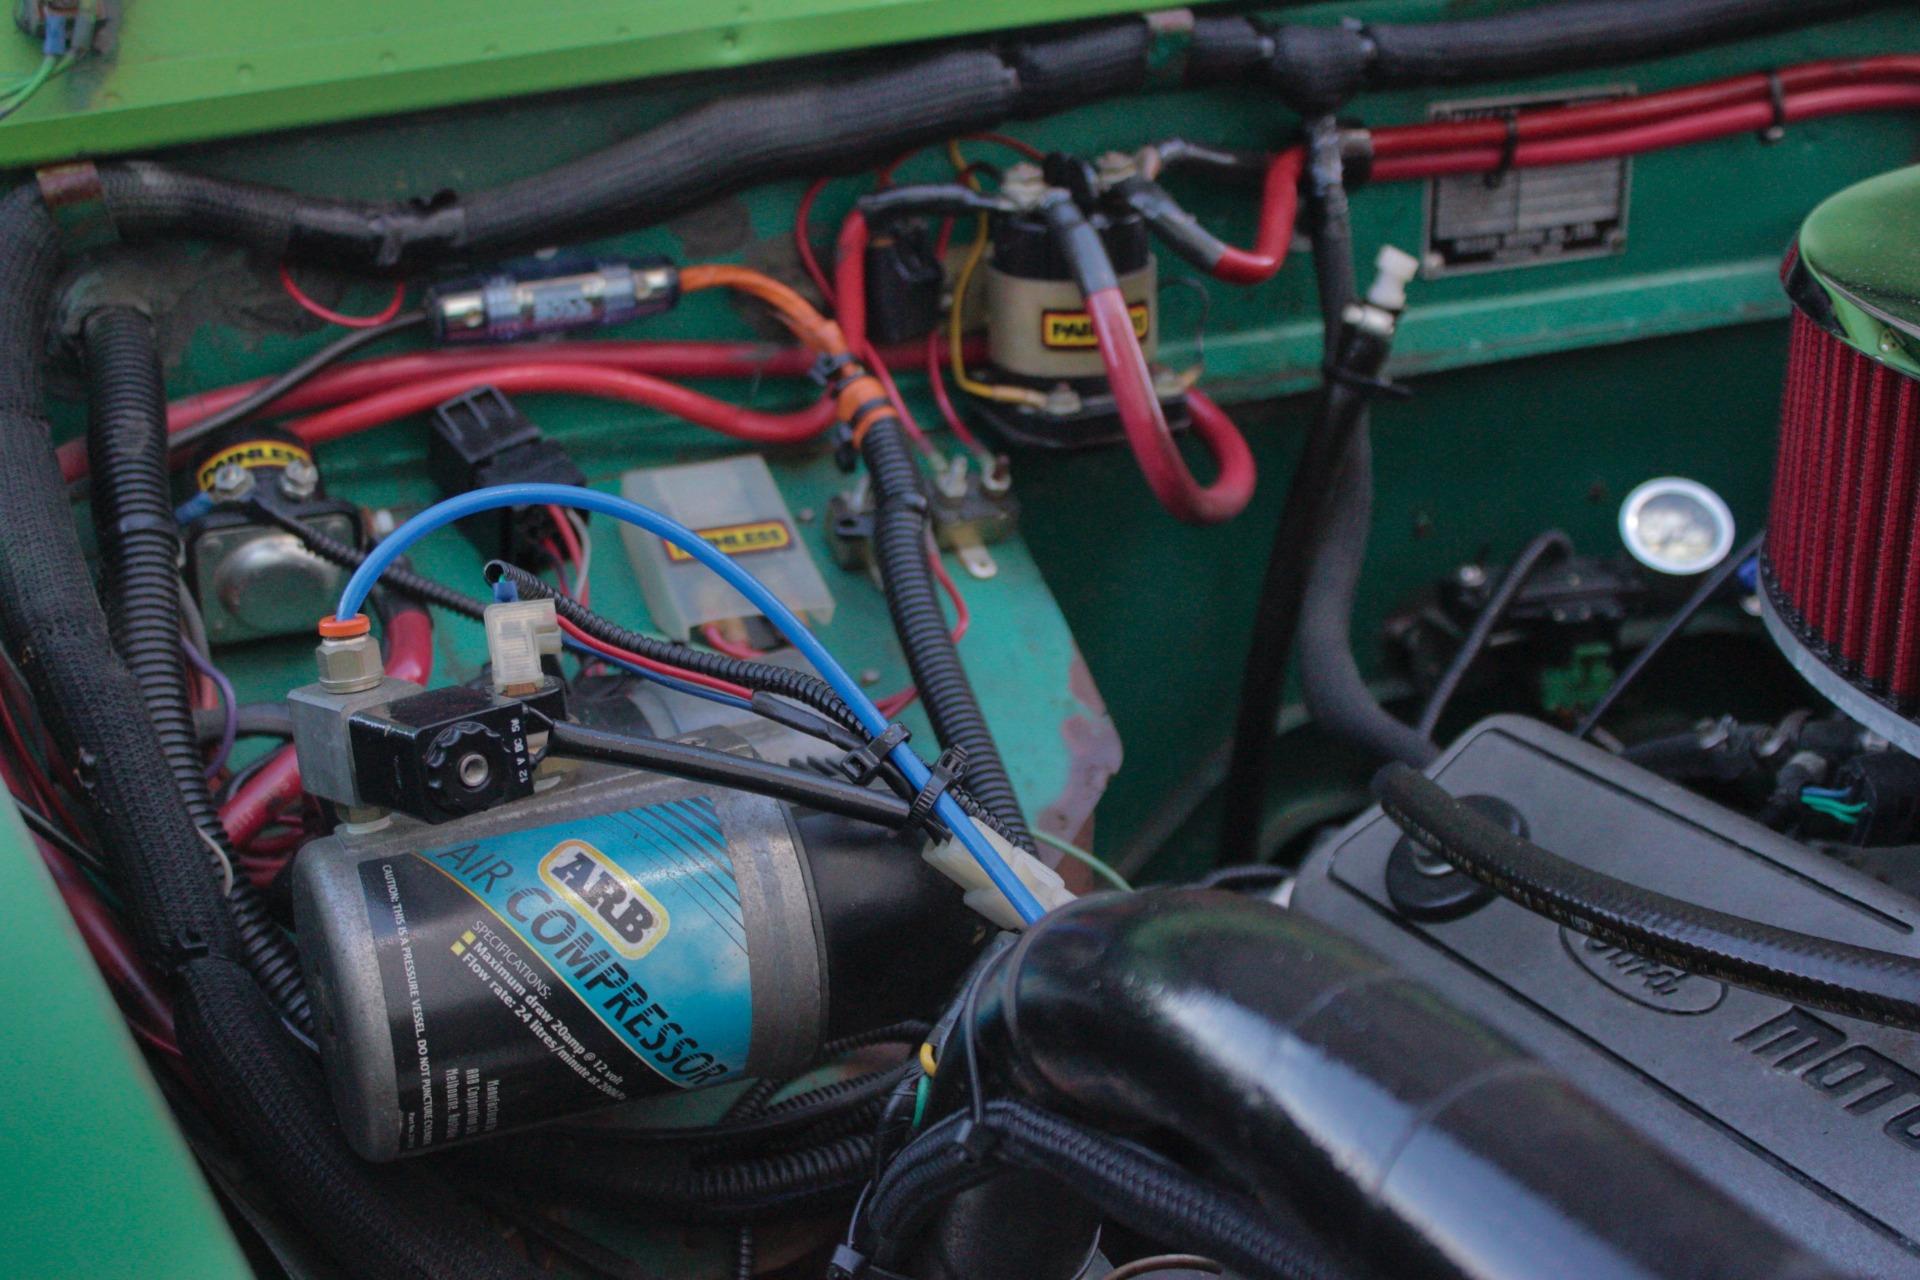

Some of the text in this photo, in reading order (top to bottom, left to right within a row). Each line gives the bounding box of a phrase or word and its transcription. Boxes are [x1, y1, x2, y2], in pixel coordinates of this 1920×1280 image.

[511, 718, 528, 783] 12 V DC 5W
[382, 864, 400, 902] CAUTION:
[437, 844, 513, 893] AIR
[392, 903, 406, 926] THIS
[550, 852, 655, 945] ARB
[398, 925, 408, 936] IS
[400, 937, 409, 946] A
[402, 946, 419, 998] PRESSURE
[472, 920, 551, 999] SPECIFICATIONS:
[507, 887, 728, 1084] COMPRESSOR
[411, 998, 425, 1038] VESSEL.
[462, 952, 491, 981] Flow
[489, 981, 516, 1008] rate:
[514, 1004, 533, 1023] 24
[529, 1019, 590, 1079] litres/minute
[588, 1075, 600, 1085] at
[473, 941, 623, 1085] Maximum draw 20amp @ 12 volt
[417, 1039, 428, 1056] DO
[419, 1056, 431, 1077] NOT
[422, 1078, 433, 1120] PUNCTURE
